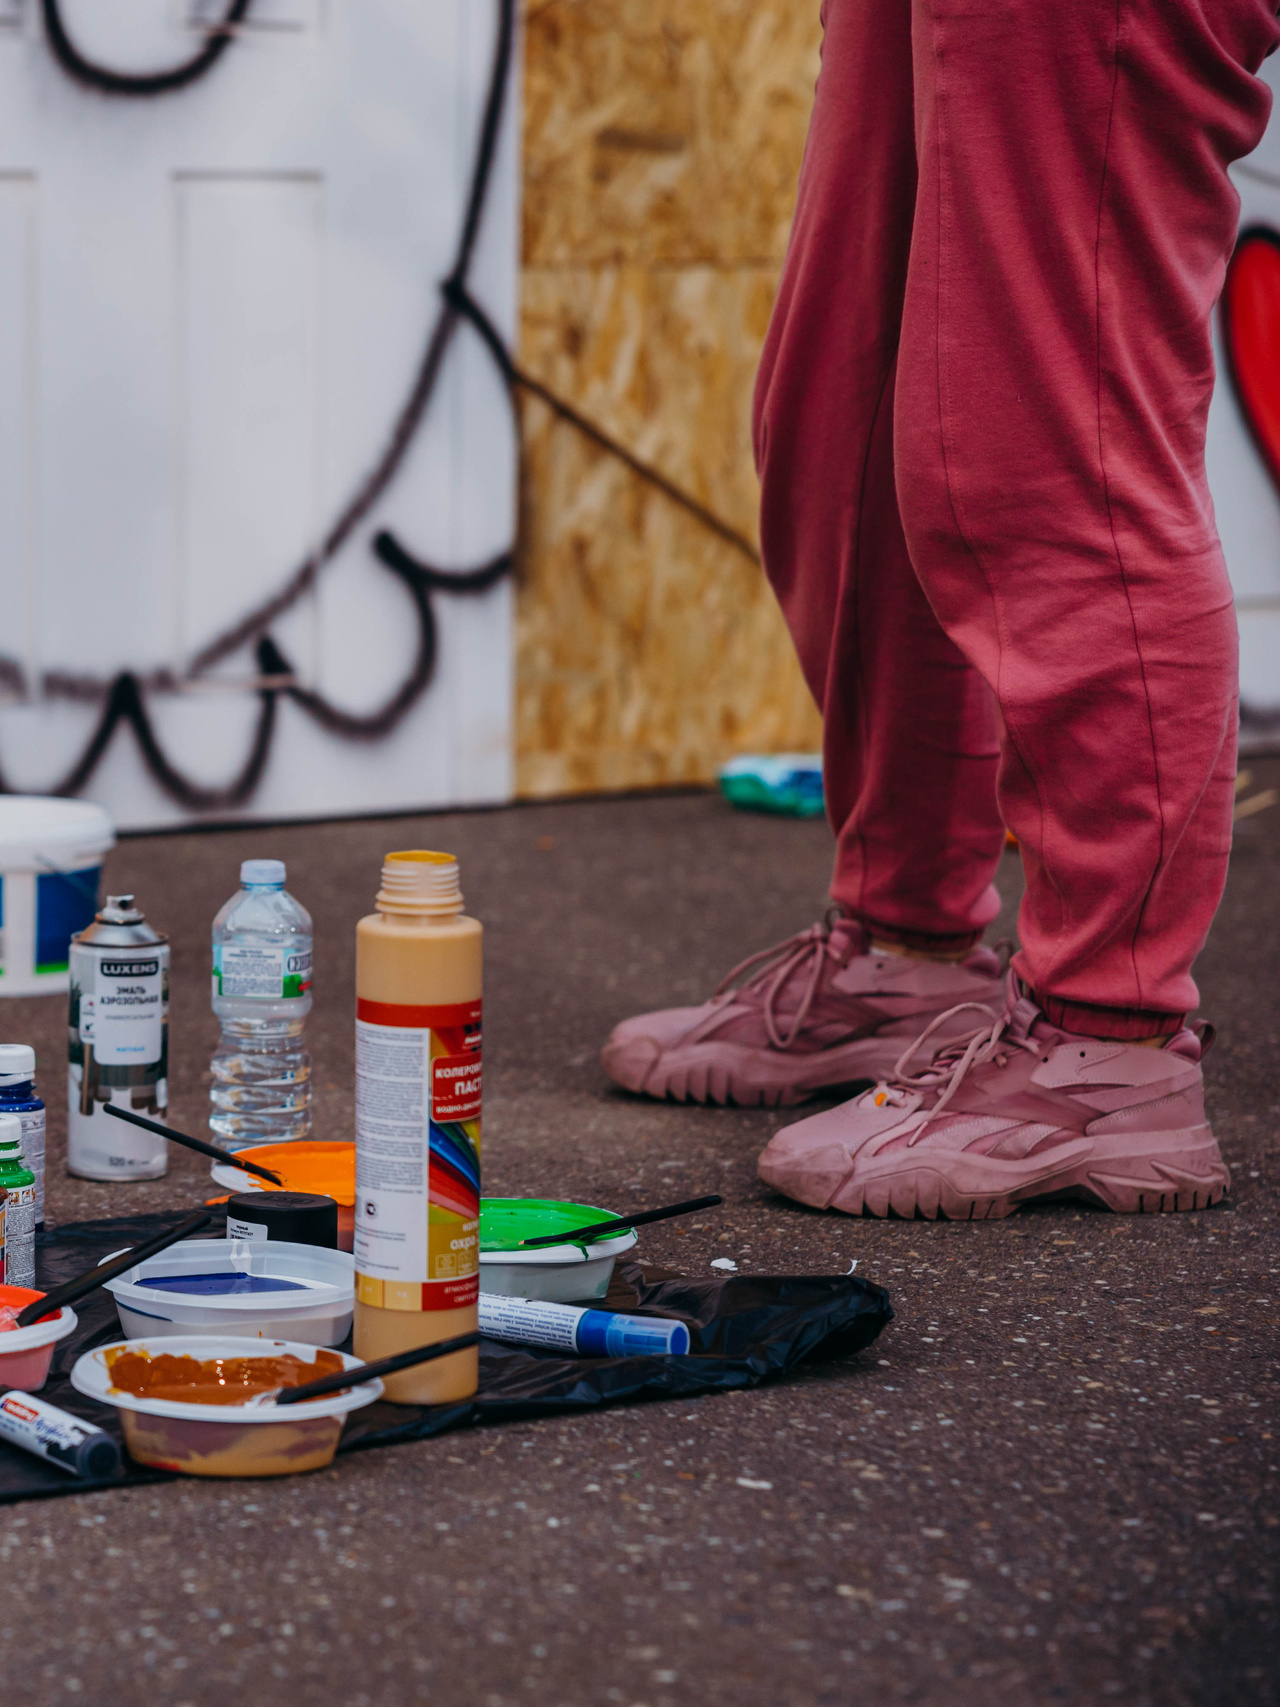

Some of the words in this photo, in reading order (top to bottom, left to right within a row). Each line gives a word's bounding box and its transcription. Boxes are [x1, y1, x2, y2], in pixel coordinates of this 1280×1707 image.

[103, 963, 156, 974] LUXENS
[116, 986, 146, 994] ЭМАЛЬ
[101, 994, 158, 1005] АЭРОЗОЛЬНАЯ
[450, 1236, 475, 1250] охра
